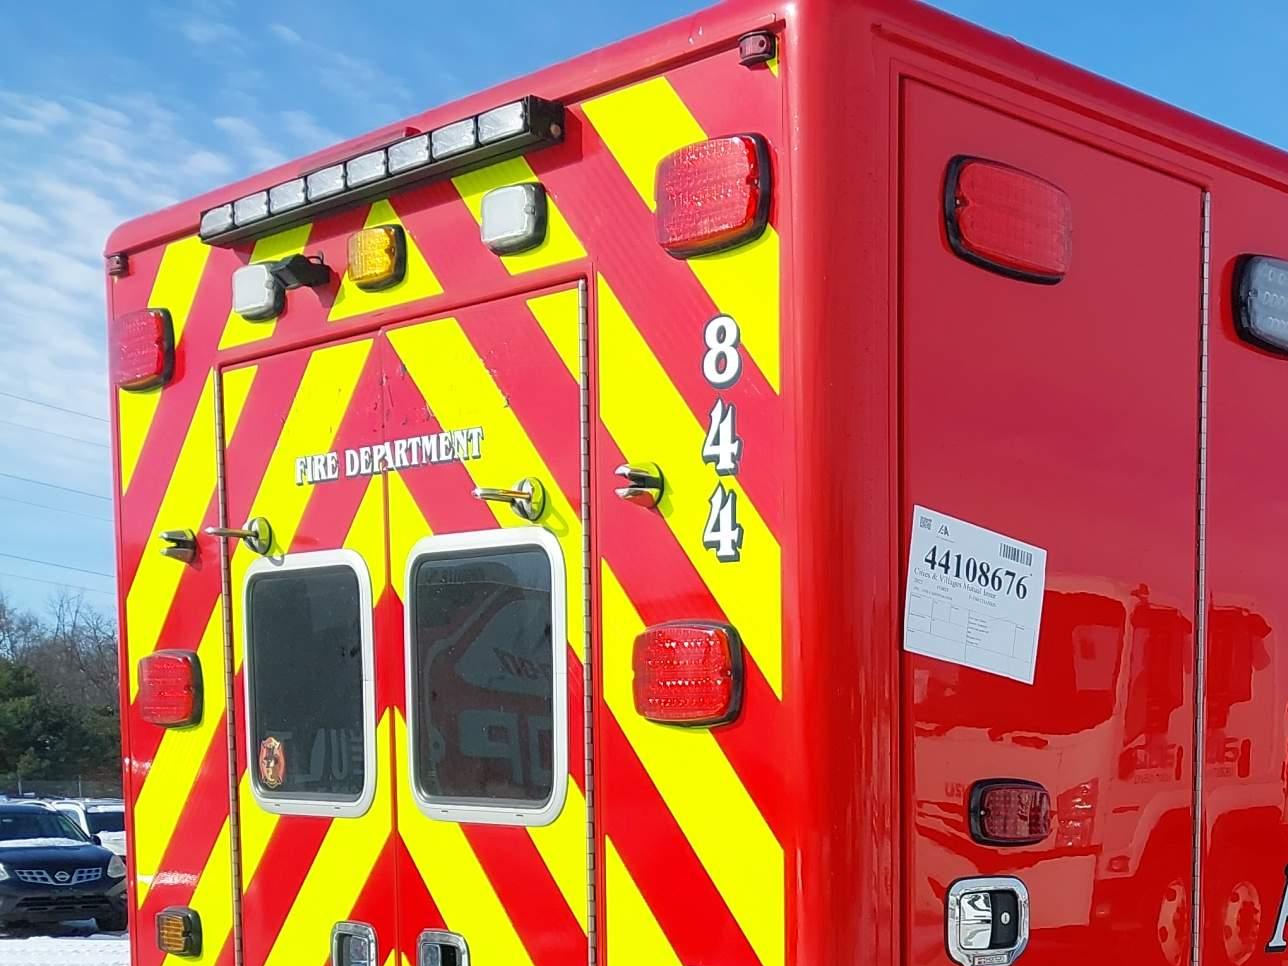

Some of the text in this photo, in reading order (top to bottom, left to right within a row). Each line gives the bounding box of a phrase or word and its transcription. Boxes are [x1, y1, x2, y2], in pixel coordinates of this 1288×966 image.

[295, 426, 485, 486] FIRE DEPARTMENT
[924, 545, 1028, 600] 44108676
